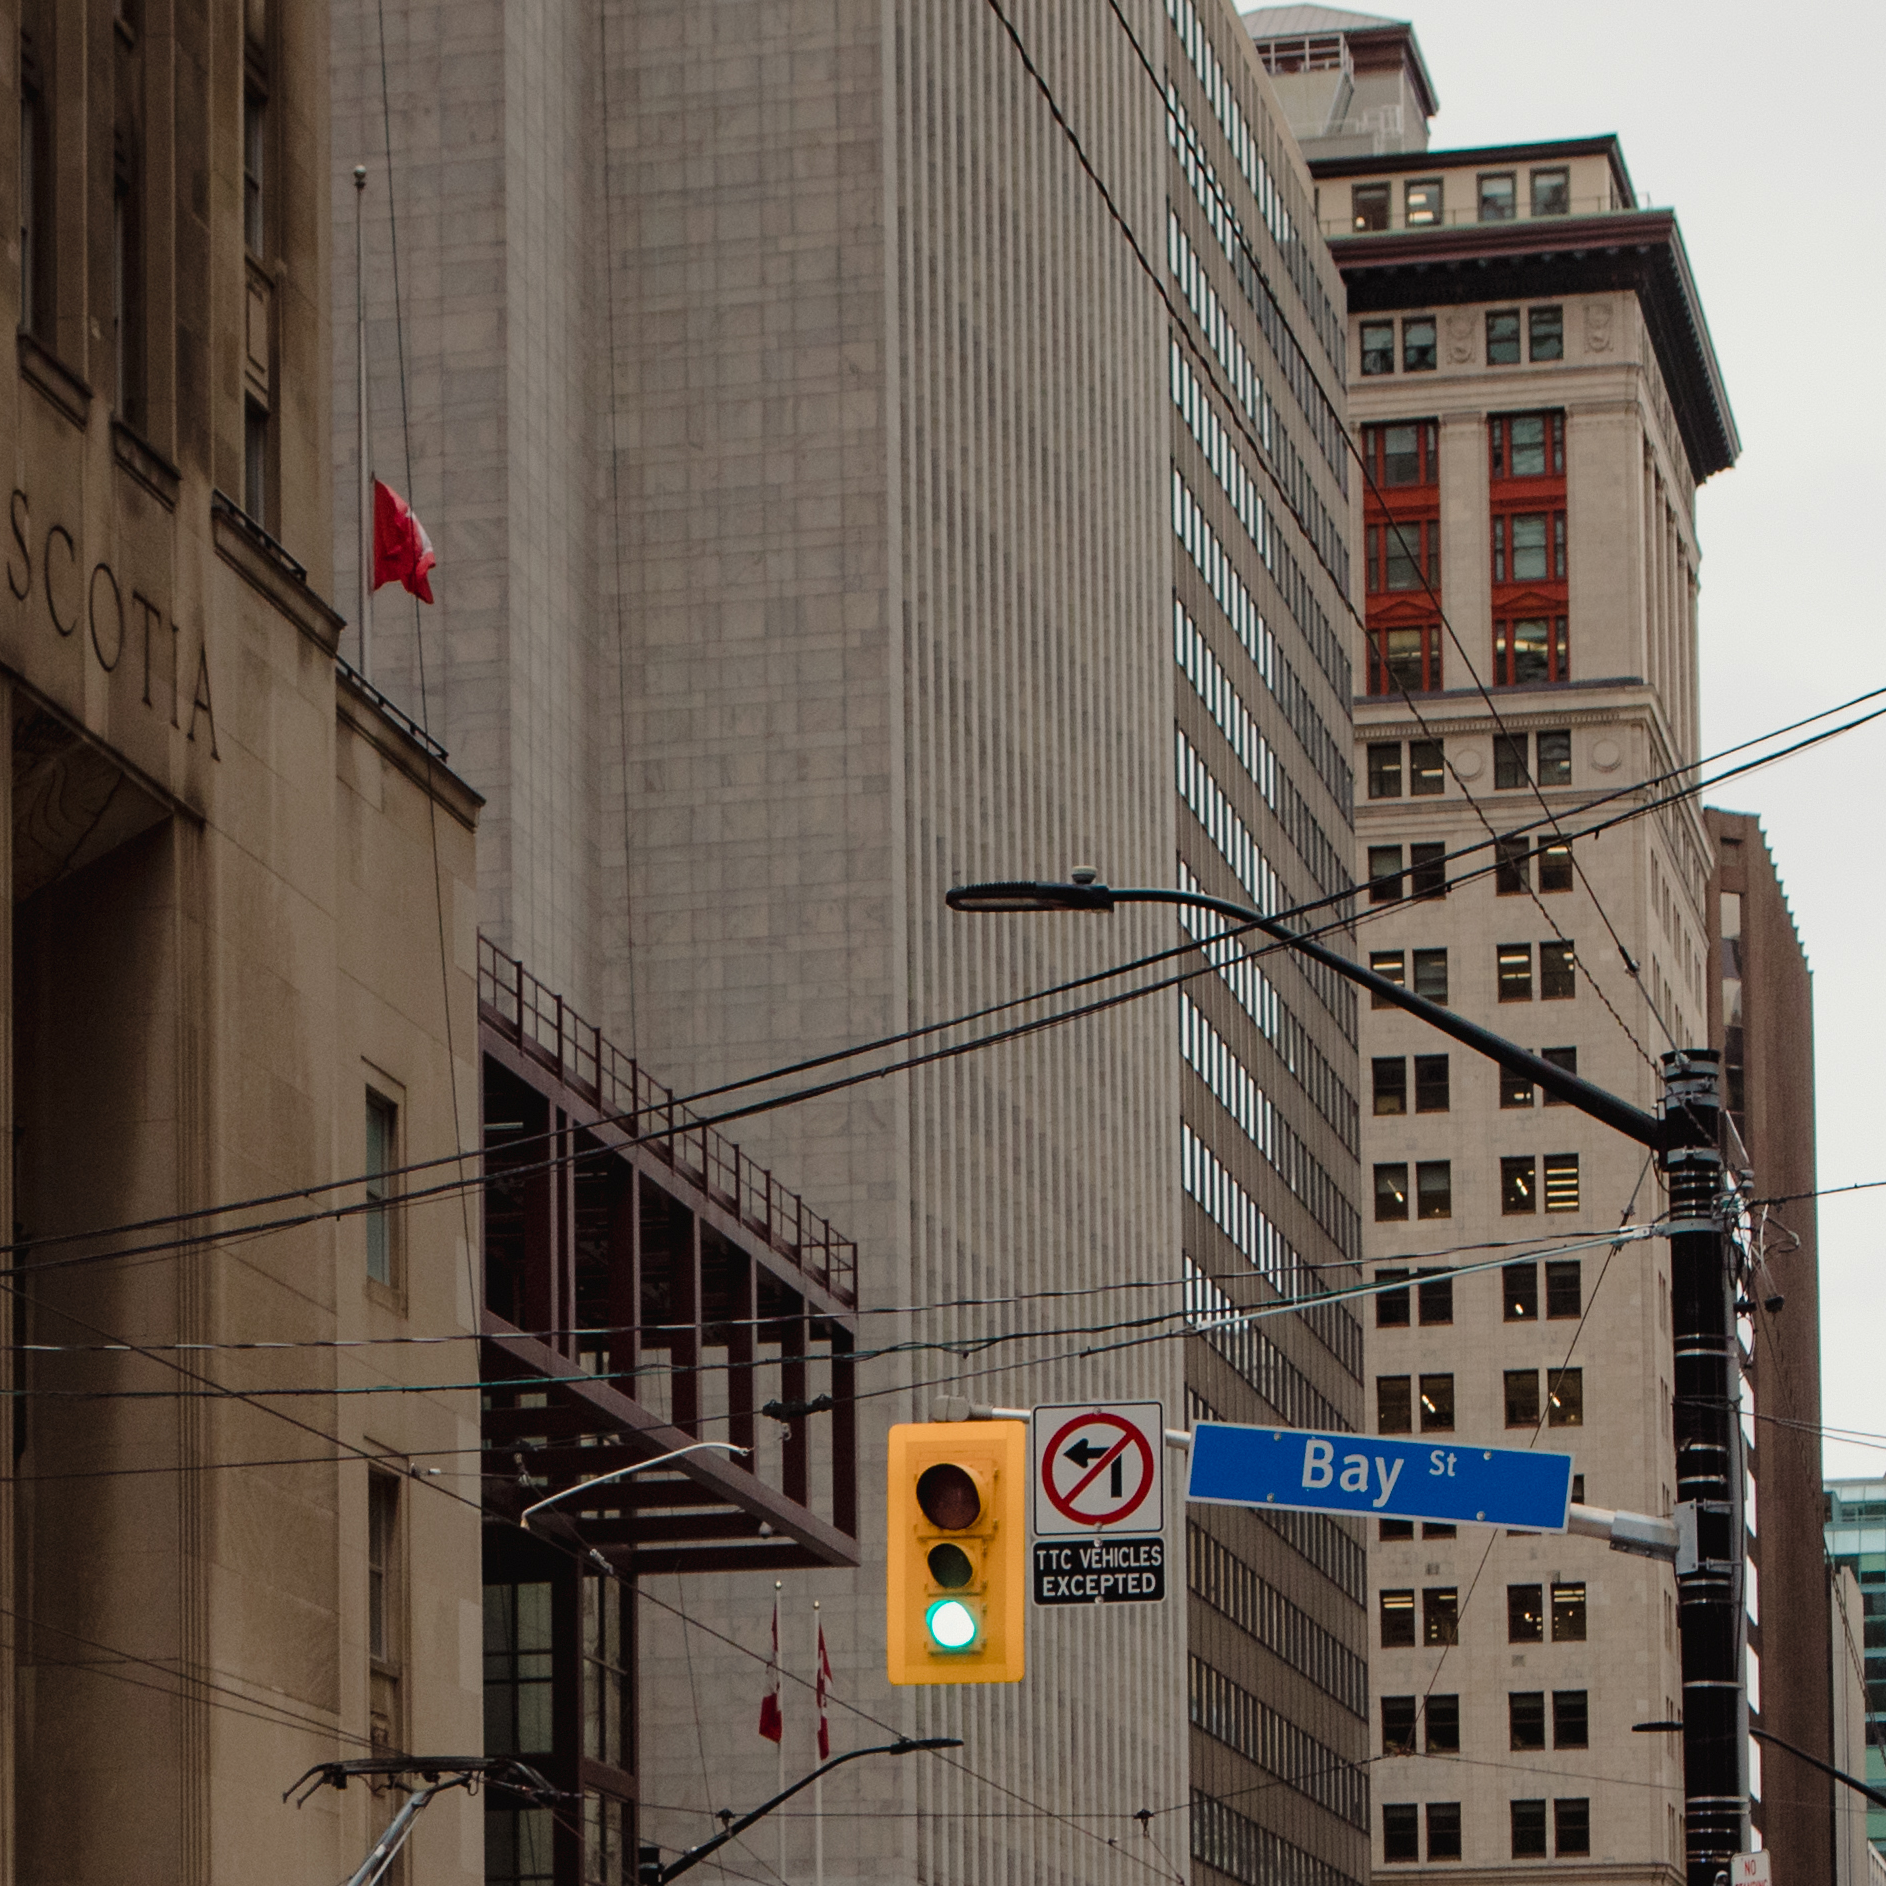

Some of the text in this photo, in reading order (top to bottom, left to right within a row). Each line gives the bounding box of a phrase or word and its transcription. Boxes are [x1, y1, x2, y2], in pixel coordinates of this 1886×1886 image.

[6, 489, 221, 763] SCOTIA
[1302, 1439, 1458, 1508] Bay St
[1036, 1544, 1163, 1570] TTC VEHICLES
[1042, 1572, 1157, 1598] EXCEPTED
[1743, 1858, 1757, 1877] NO
